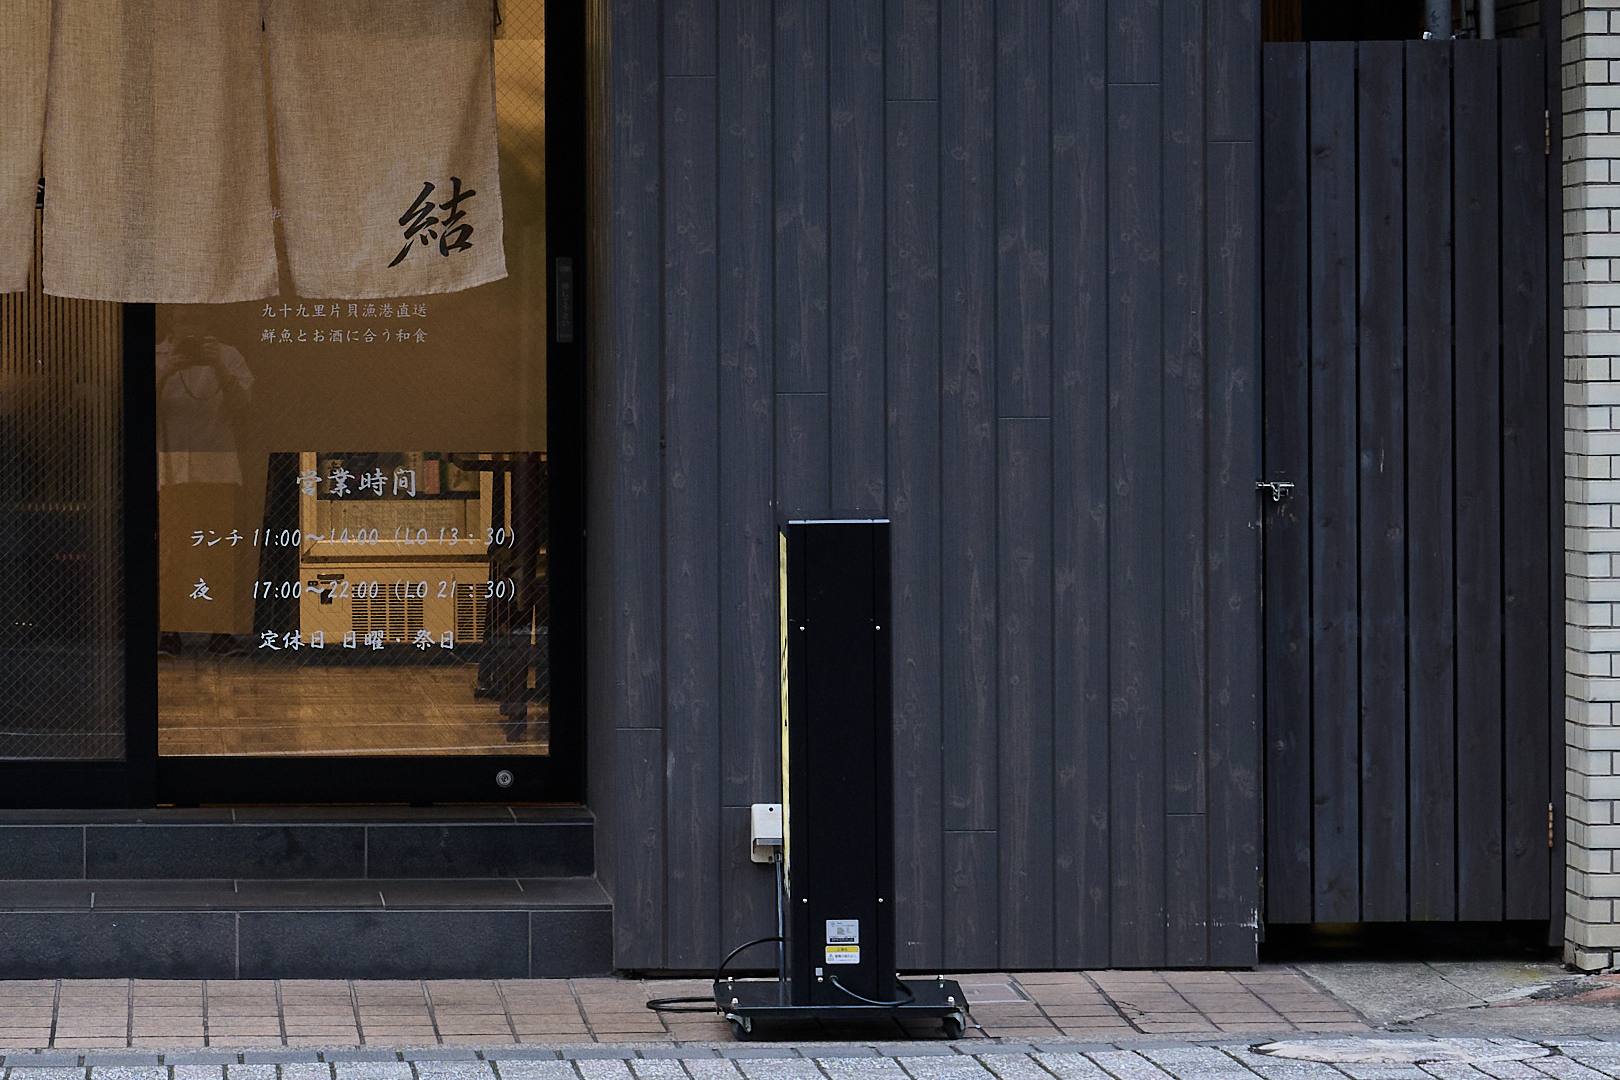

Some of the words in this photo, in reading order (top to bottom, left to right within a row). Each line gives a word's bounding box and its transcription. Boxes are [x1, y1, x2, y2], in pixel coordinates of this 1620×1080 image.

[387, 176, 477, 269] 結
[261, 302, 428, 319] 九十九里片貝漁港直送
[260, 327, 429, 344] 鮮魚とお酒に合う和食
[296, 467, 417, 497] 営業時間
[189, 529, 244, 548] ランチ
[189, 578, 213, 601] 夜
[258, 630, 325, 651] 定休日
